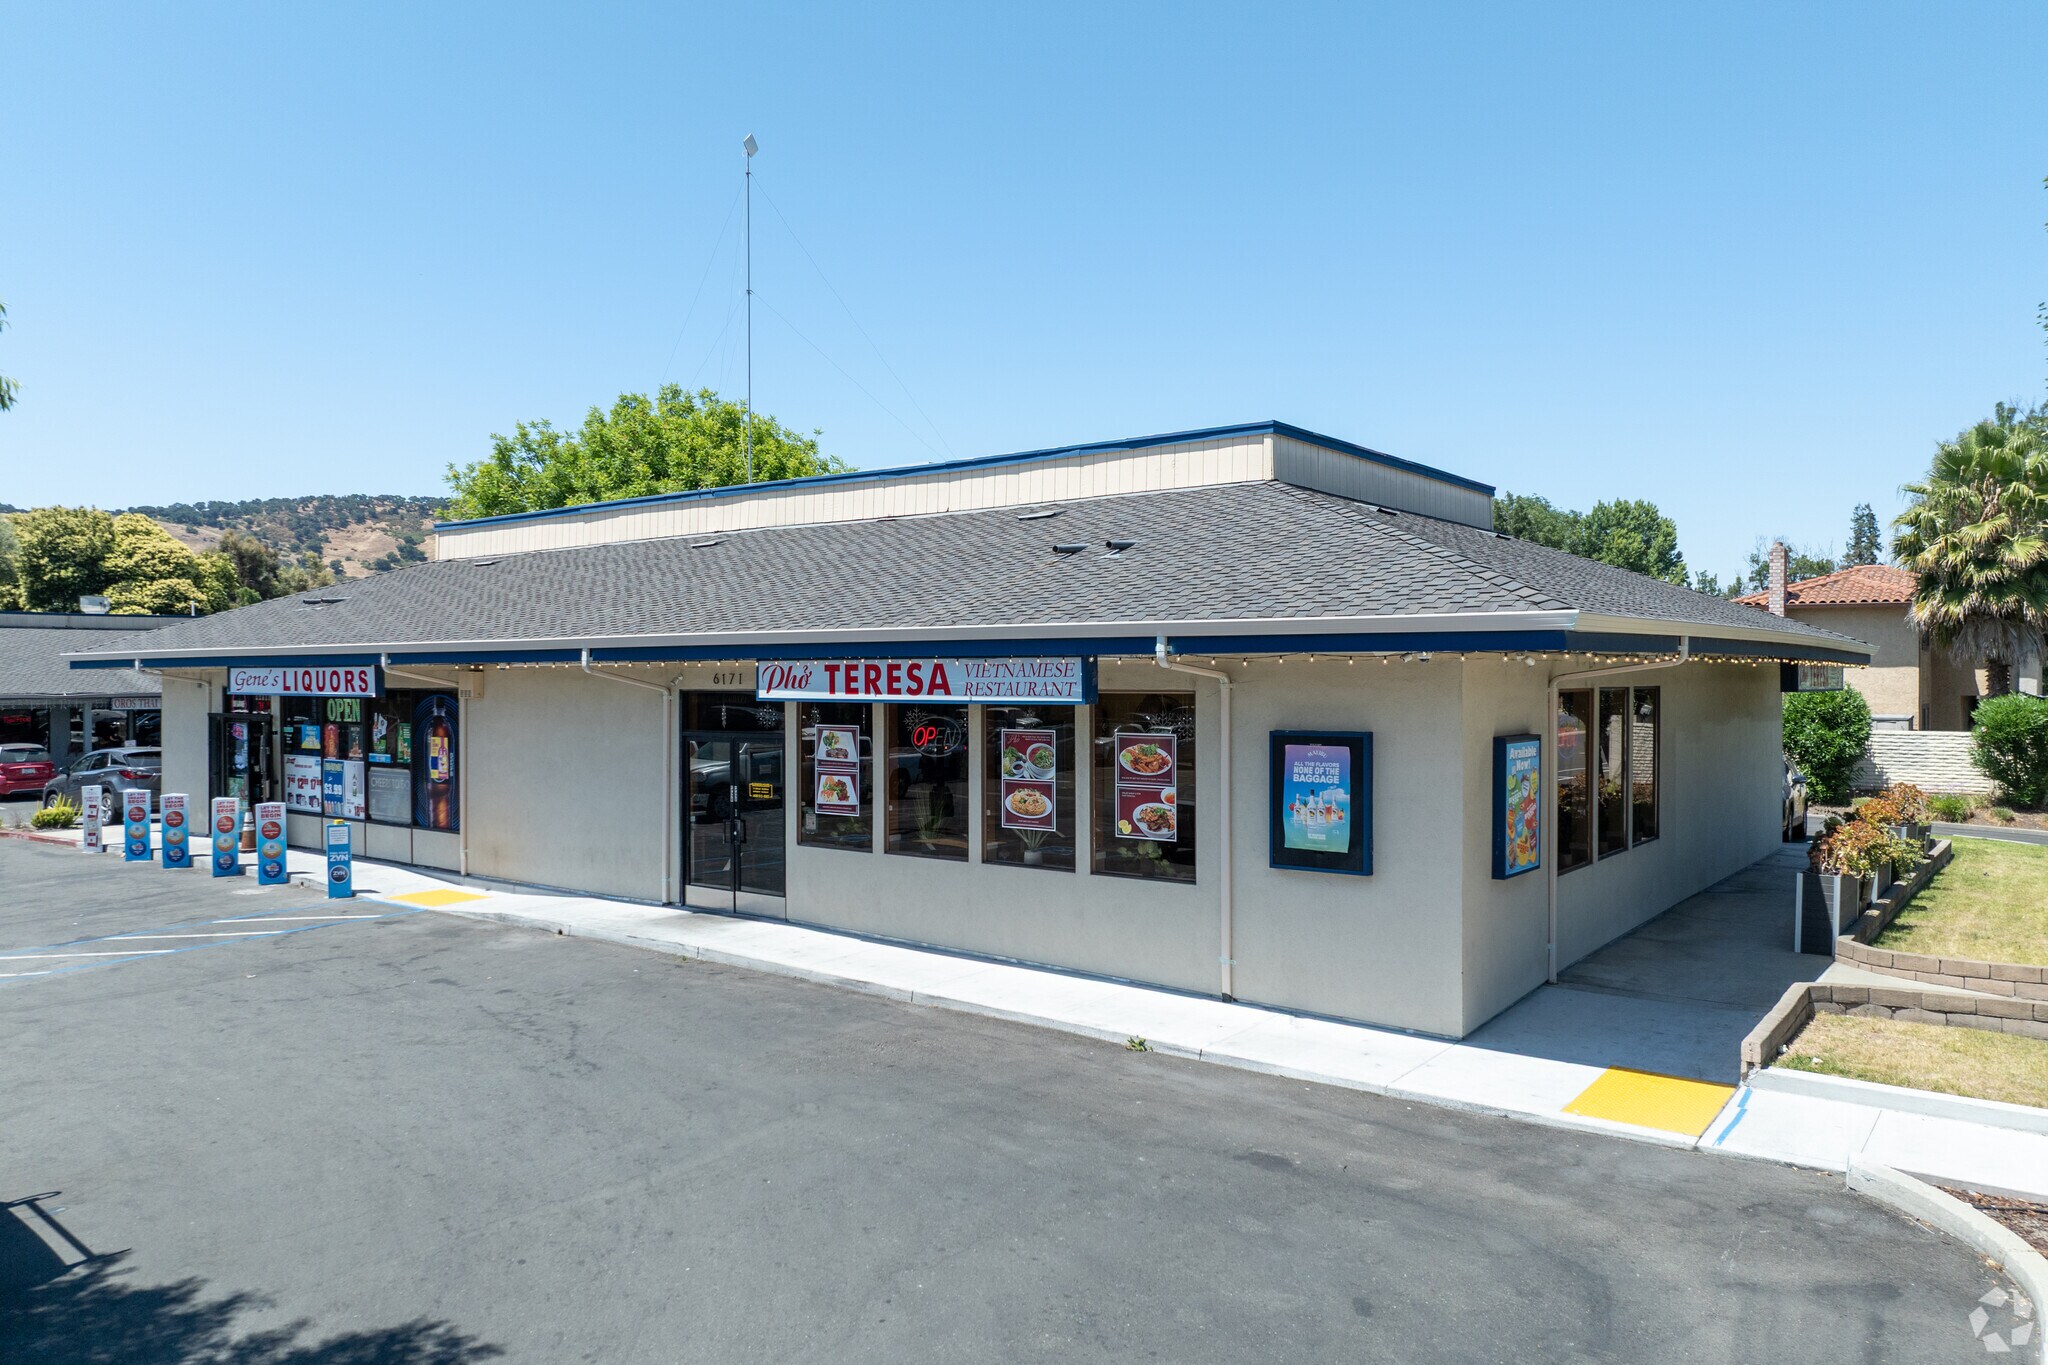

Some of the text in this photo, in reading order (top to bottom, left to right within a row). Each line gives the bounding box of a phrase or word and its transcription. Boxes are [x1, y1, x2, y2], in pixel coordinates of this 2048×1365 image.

[964, 663, 1076, 679] VIETNAMESE
[234, 669, 369, 692] Gene's LIQUORS
[713, 673, 743, 685] 6171
[824, 663, 952, 696] TERESA
[964, 681, 1077, 697] RESTAURANT
[138, 699, 159, 709] THAI
[326, 698, 360, 722] OPEN
[913, 726, 957, 746] OPEN
[1510, 745, 1537, 760] Available
[1293, 766, 1340, 776] NONE OF THE
[1516, 759, 1531, 772] Now!
[1293, 773, 1340, 784] BAGGAGE
[329, 854, 348, 862] ZYN
